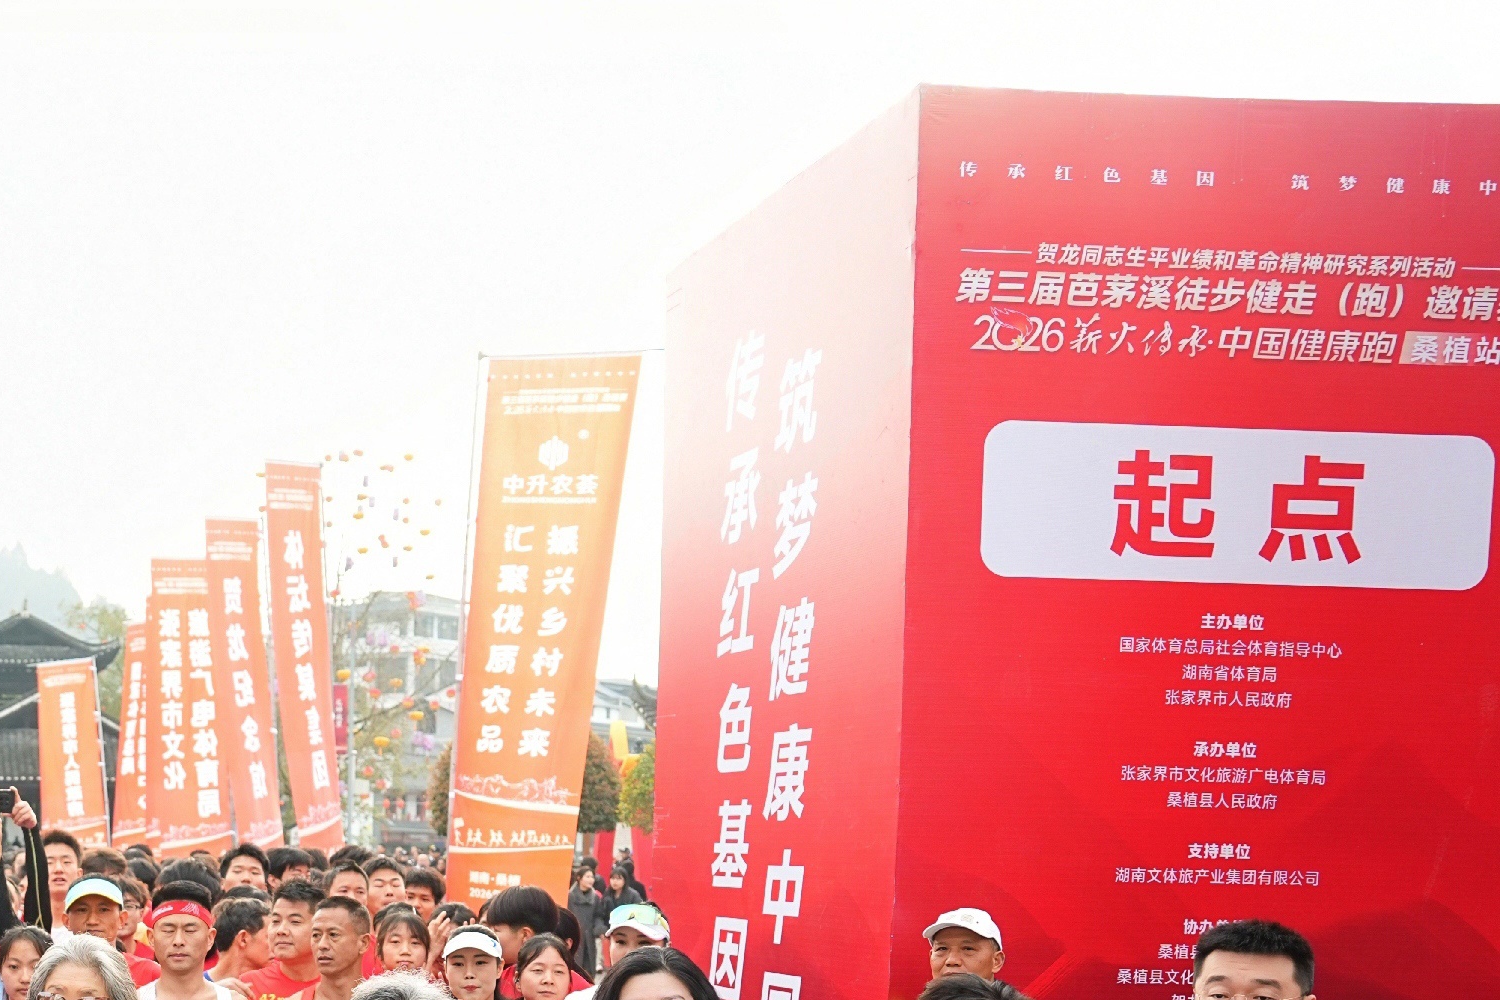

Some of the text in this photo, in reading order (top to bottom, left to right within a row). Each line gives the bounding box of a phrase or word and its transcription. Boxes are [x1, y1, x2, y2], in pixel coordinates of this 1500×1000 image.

[958, 159, 1216, 188] 传承红色基因
[1035, 241, 1457, 280] 贺龙同志生平业绩和革命精神研究系列活动
[954, 266, 1500, 324] 第三届芭茅溪徒步健走（跑）邀请
[1109, 448, 1366, 566] 起点
[1200, 613, 1265, 632] 主办单位
[475, 523, 536, 754] 汇聚优质农品
[517, 524, 580, 758] 振兴乡村未来
[1119, 635, 1343, 660] 国家体育总局社会体育指导中心
[1181, 663, 1278, 683] 湖南省体育局
[1164, 688, 1293, 709] 张家界市人民政府
[1193, 741, 1257, 759] 承办单位
[1120, 764, 1327, 786] 张家界市文化旅游广电体育局
[1166, 790, 1278, 810] 桑植县人民政府
[1187, 842, 1251, 861] 支持单位
[1114, 866, 1320, 887] 湖南文体旅产业集团有限公司
